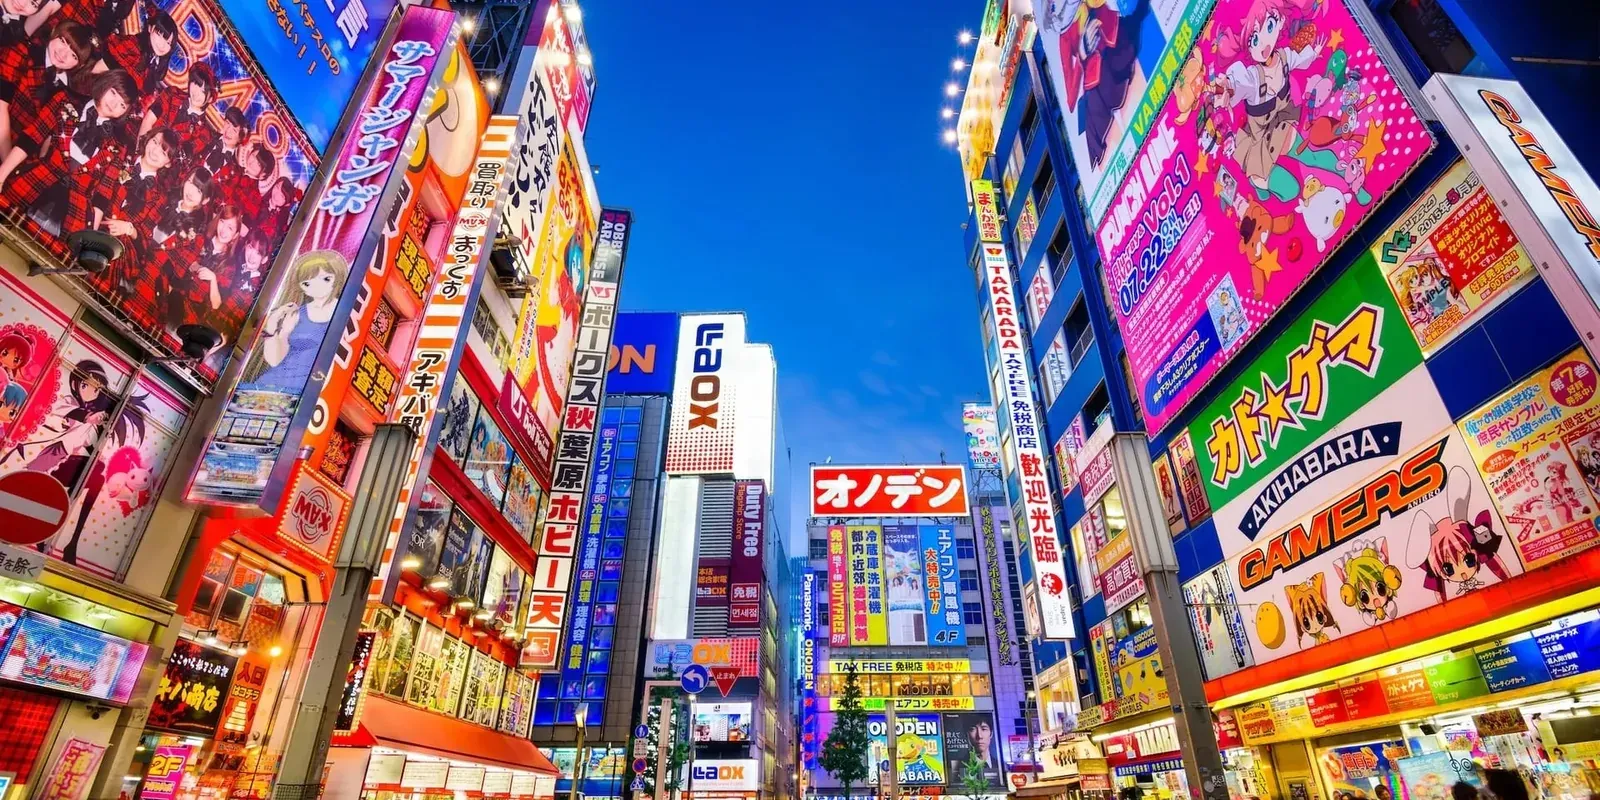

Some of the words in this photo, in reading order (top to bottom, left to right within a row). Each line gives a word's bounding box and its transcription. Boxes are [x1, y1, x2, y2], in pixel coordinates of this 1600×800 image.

[319, 40, 435, 216] サマージャンボ
[470, 162, 501, 209] 買取り
[1100, 169, 1147, 263] PUNCH
[1140, 112, 1179, 193] LINE
[610, 213, 629, 258] HOBBY
[977, 192, 998, 239] まんが喫茶
[1164, 191, 1202, 253] SALE!!
[593, 213, 614, 279] PARADISE
[1119, 234, 1164, 316] 07.22
[1160, 208, 1177, 237] ON
[1457, 225, 1495, 261] オリジナル
[442, 235, 476, 298] まっくす
[1470, 250, 1518, 294] 好評発売中!!
[989, 266, 1020, 349] TAKARADA
[1410, 277, 1450, 316] SAMPLE
[1550, 363, 1590, 394] 第7巻
[1566, 380, 1584, 395] 好評
[1011, 400, 1037, 449] 免税商店
[735, 484, 746, 516] Flagship
[816, 468, 962, 509] オノデン
[1252, 429, 1381, 528] AKIHABARA
[743, 484, 763, 520] Duty
[1238, 435, 1450, 592] GAMERS
[735, 517, 744, 540] Store
[743, 522, 762, 557] Free
[829, 530, 843, 556] 免税
[866, 530, 879, 570] 冷蔵庫
[580, 570, 595, 580] 4F
[938, 529, 955, 580] エアコン
[733, 586, 758, 599] 免税
[804, 574, 814, 631] Panasonic
[867, 572, 882, 614] 洗濯機
[925, 549, 940, 614] 大特売中!!
[943, 581, 960, 625] 扇風機
[832, 582, 845, 634] DUTYFREE
[237, 662, 266, 685] 入口
[716, 671, 736, 680] 止まれ
[804, 639, 814, 690] ONODEN
[836, 662, 859, 672] TAX
[862, 663, 893, 671] FREE
[896, 662, 923, 672] 免税店
[896, 699, 930, 708] エアコン
[933, 698, 969, 709] 特売中!!
[150, 755, 183, 776] 2F
